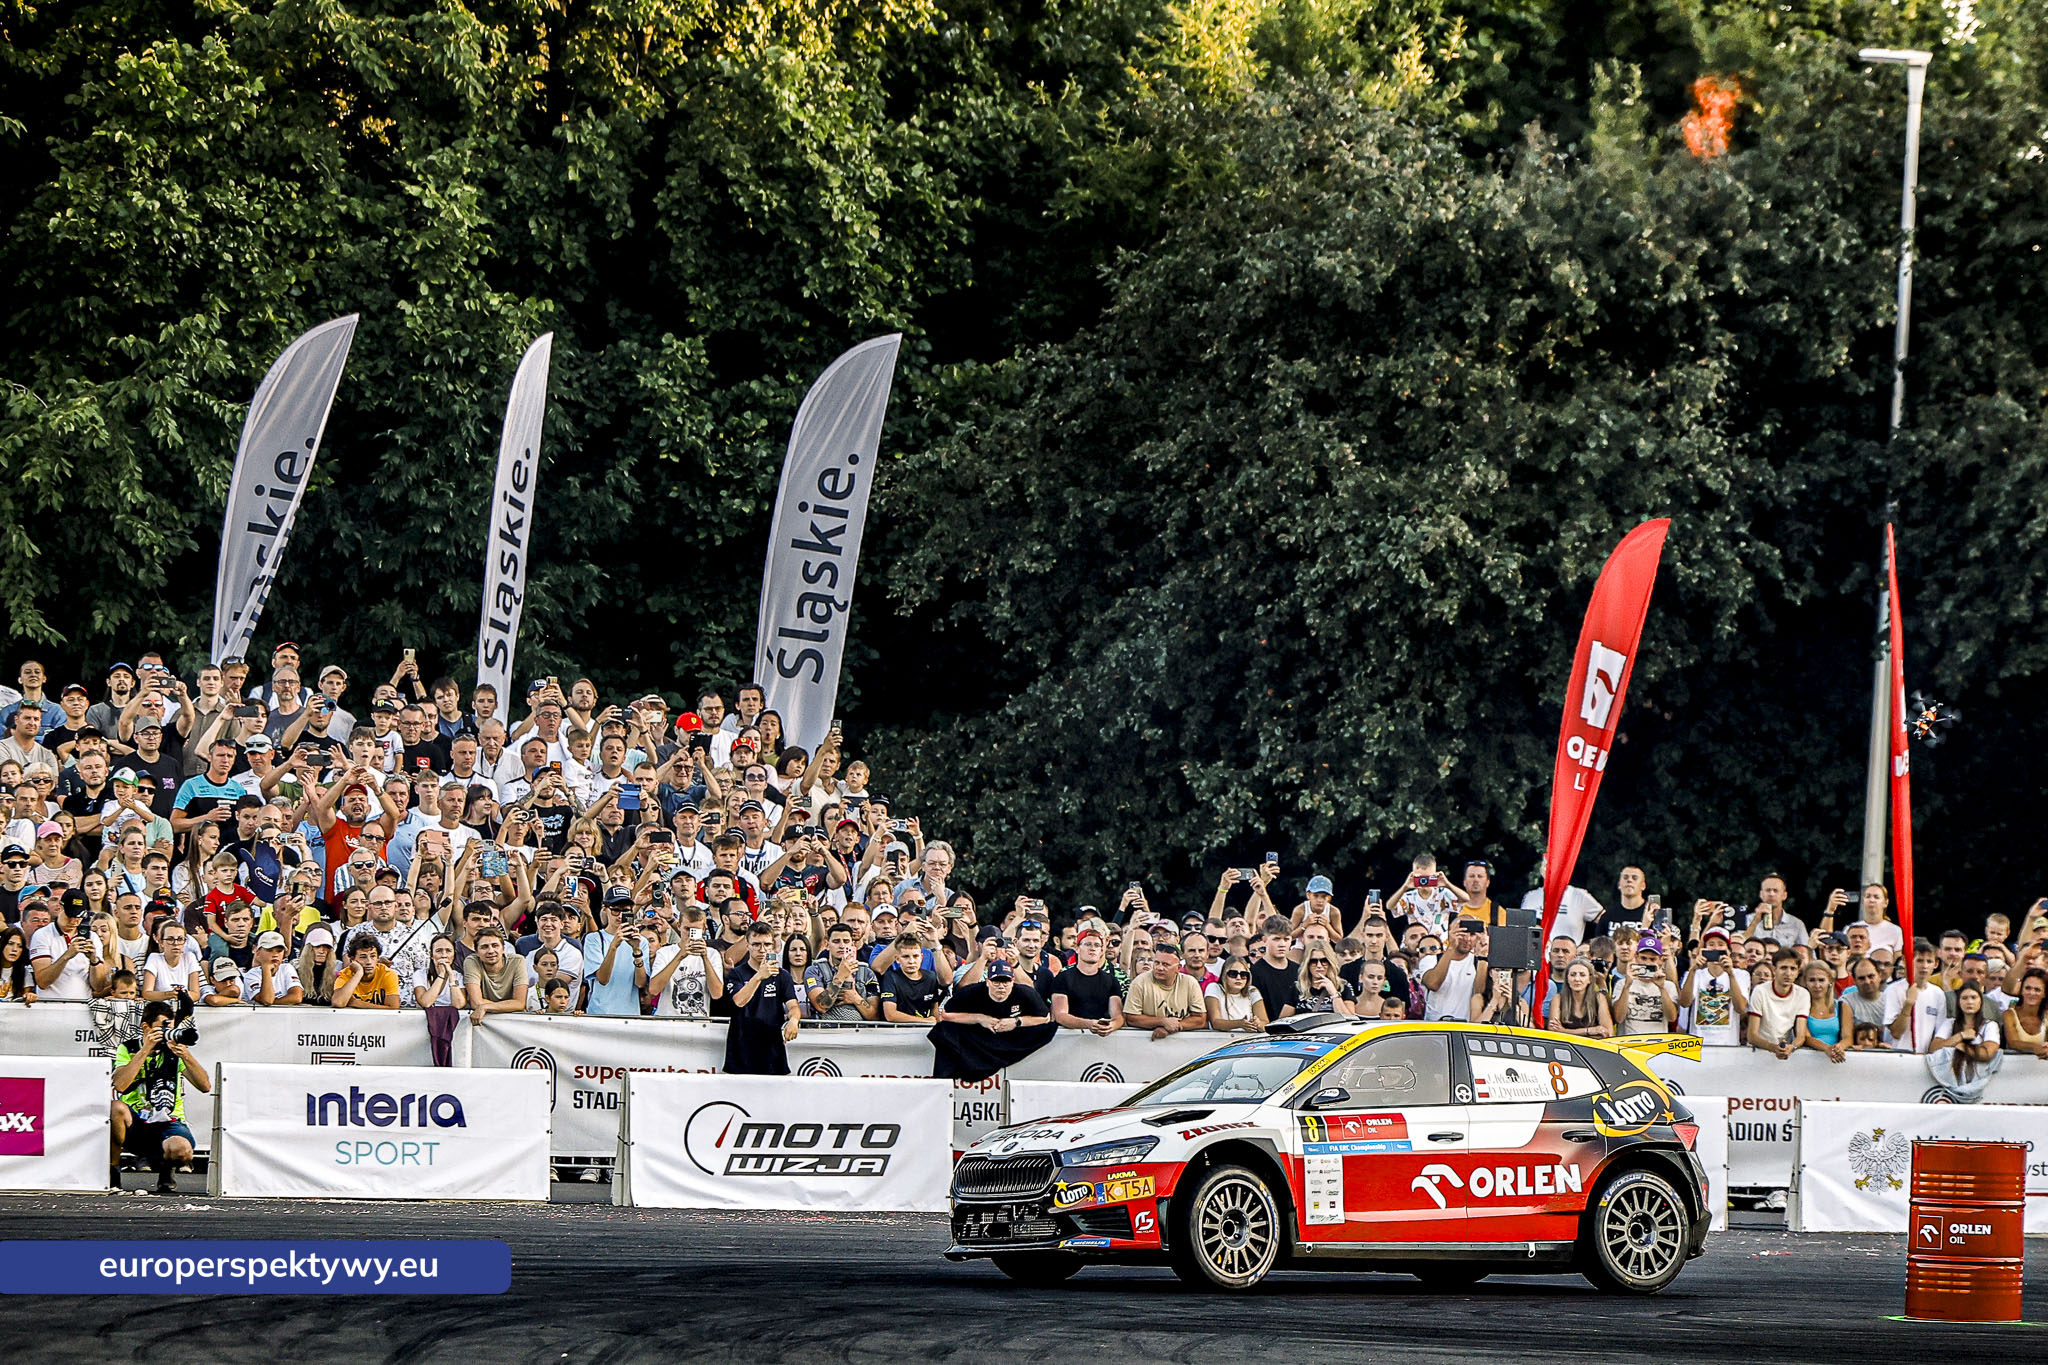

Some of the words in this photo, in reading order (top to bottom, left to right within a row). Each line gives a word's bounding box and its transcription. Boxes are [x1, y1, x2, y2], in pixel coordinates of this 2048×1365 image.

[766, 453, 860, 684] Śląskie.
[297, 1033, 345, 1047] STADION
[347, 1032, 386, 1052] ŚLĄSKI
[1548, 1061, 1569, 1095] 8
[306, 1085, 467, 1128] interia
[1600, 1090, 1656, 1126] LOTTO
[734, 1122, 901, 1149] MOTO
[1304, 1116, 1320, 1142] 8
[1365, 1118, 1393, 1126] ORLEN
[335, 1140, 440, 1165] SPORT
[1351, 1144, 1387, 1152] Championship
[727, 1156, 887, 1175] WIZJA
[1107, 1170, 1137, 1180] LAKMA
[1469, 1163, 1584, 1198] ORLEN
[1060, 1185, 1088, 1204] LOTTO
[1949, 1223, 1992, 1235] ORLEN
[1949, 1236, 1965, 1245] OIL
